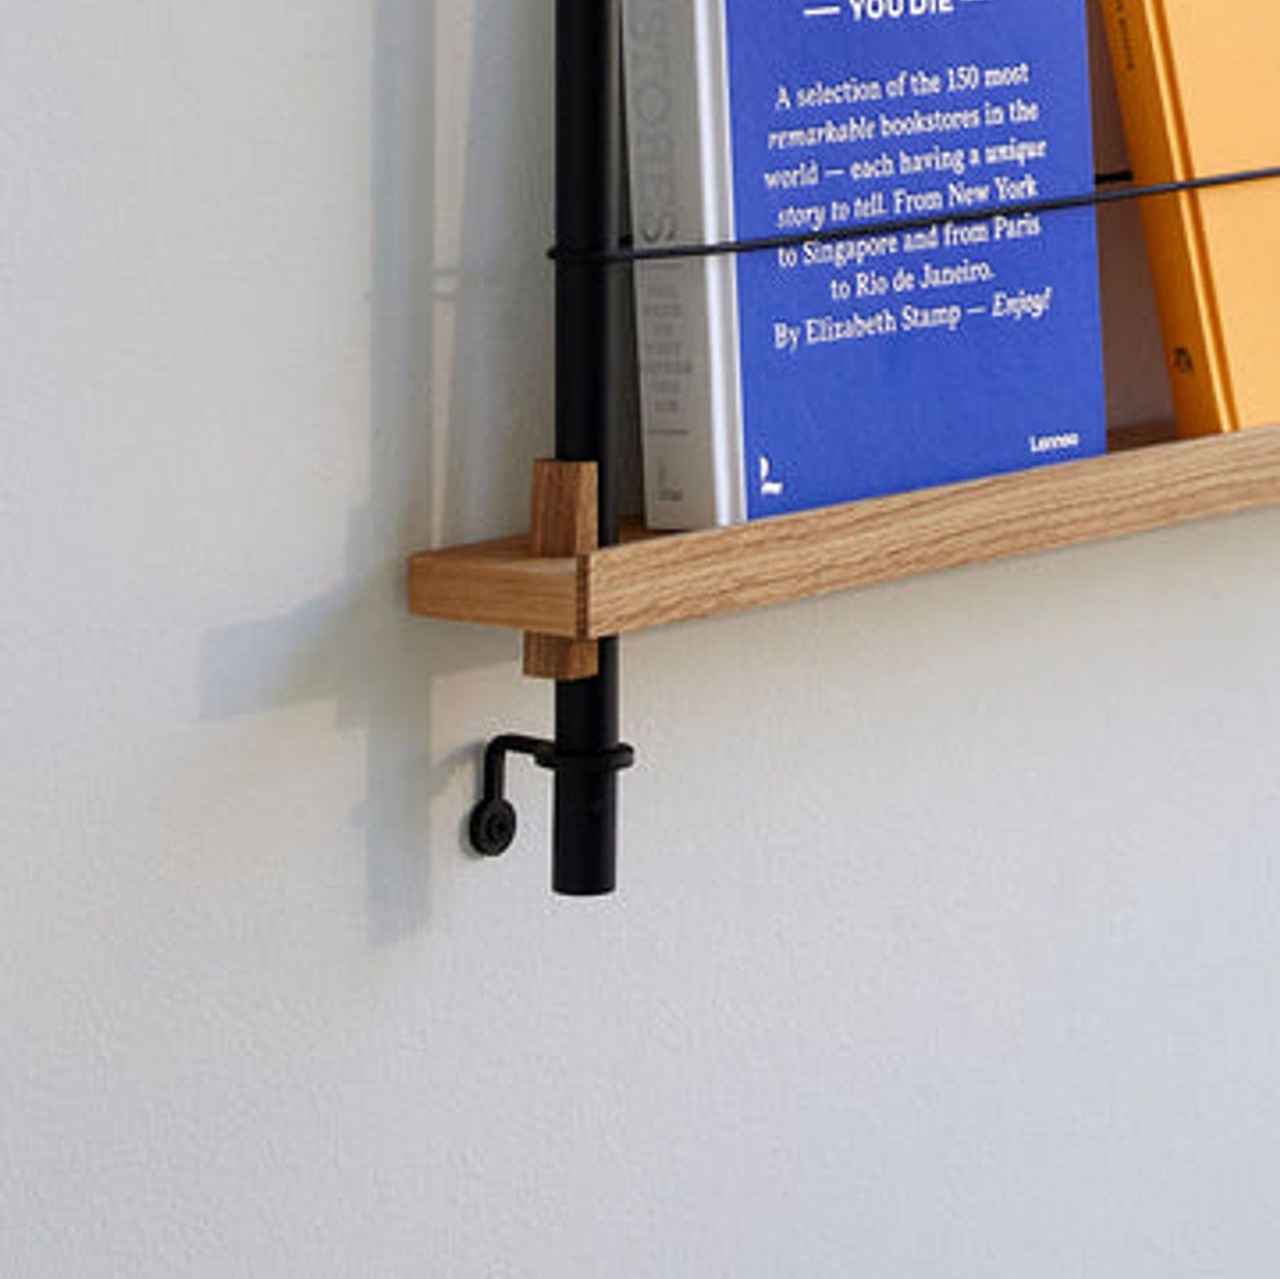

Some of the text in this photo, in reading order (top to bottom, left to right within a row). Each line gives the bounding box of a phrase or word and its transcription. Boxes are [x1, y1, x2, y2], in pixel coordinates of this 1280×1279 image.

[775, 63, 1029, 110] A selection of the 150 most
[767, 98, 1039, 149] remarkable bookstores in the
[764, 160, 819, 189] world
[850, 152, 894, 180] each
[899, 145, 965, 175] having
[968, 147, 980, 165] a
[984, 137, 1047, 166] unique
[777, 173, 1039, 232] story to tell. From New York
[778, 212, 1041, 267] to Singapore and from Paris
[830, 259, 996, 300] to Rio de Janeiro.
[774, 321, 800, 353] By
[805, 309, 896, 344] Elizabeth
[902, 303, 961, 331] Stamp
[991, 286, 1053, 321] Enjoy!
